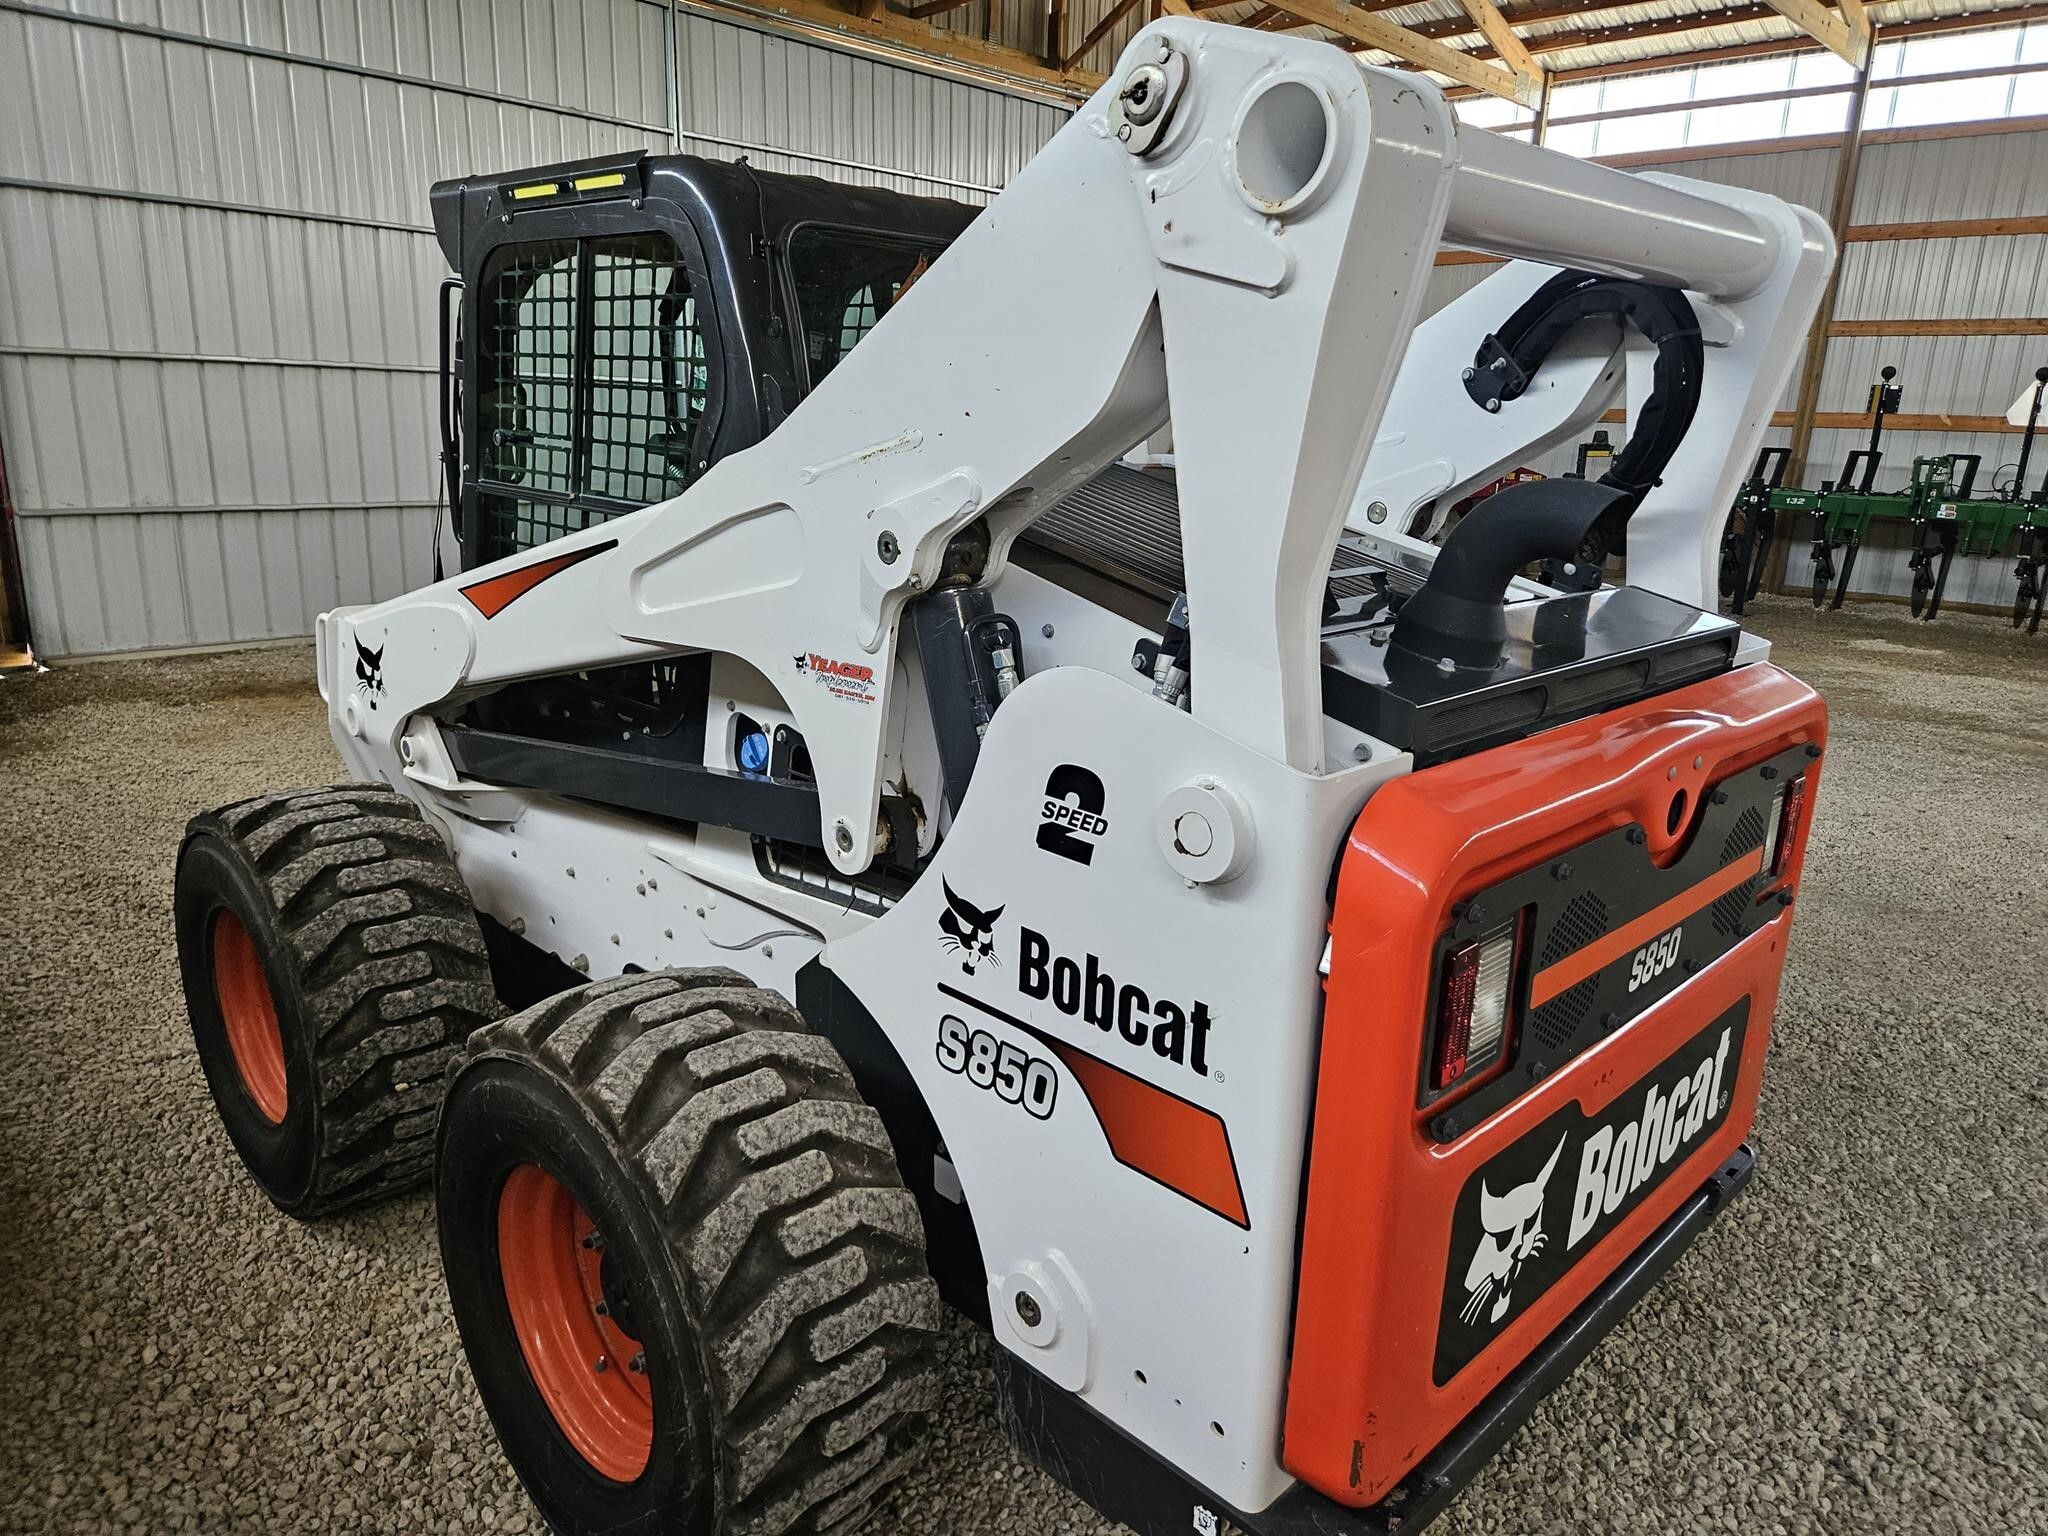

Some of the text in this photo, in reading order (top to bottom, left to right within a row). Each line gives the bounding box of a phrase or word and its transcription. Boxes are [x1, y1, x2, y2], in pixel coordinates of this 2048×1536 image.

[1785, 497, 1806, 505] 132
[808, 653, 874, 681] YEAGER
[815, 670, 876, 693] Implement
[1036, 763, 1106, 867] 2
[1041, 801, 1109, 836] SPEED
[1628, 926, 1683, 993] S850
[1018, 925, 1211, 1077] Bobcat
[935, 1014, 1058, 1121] S850
[1566, 1027, 1732, 1251] Bobcat
